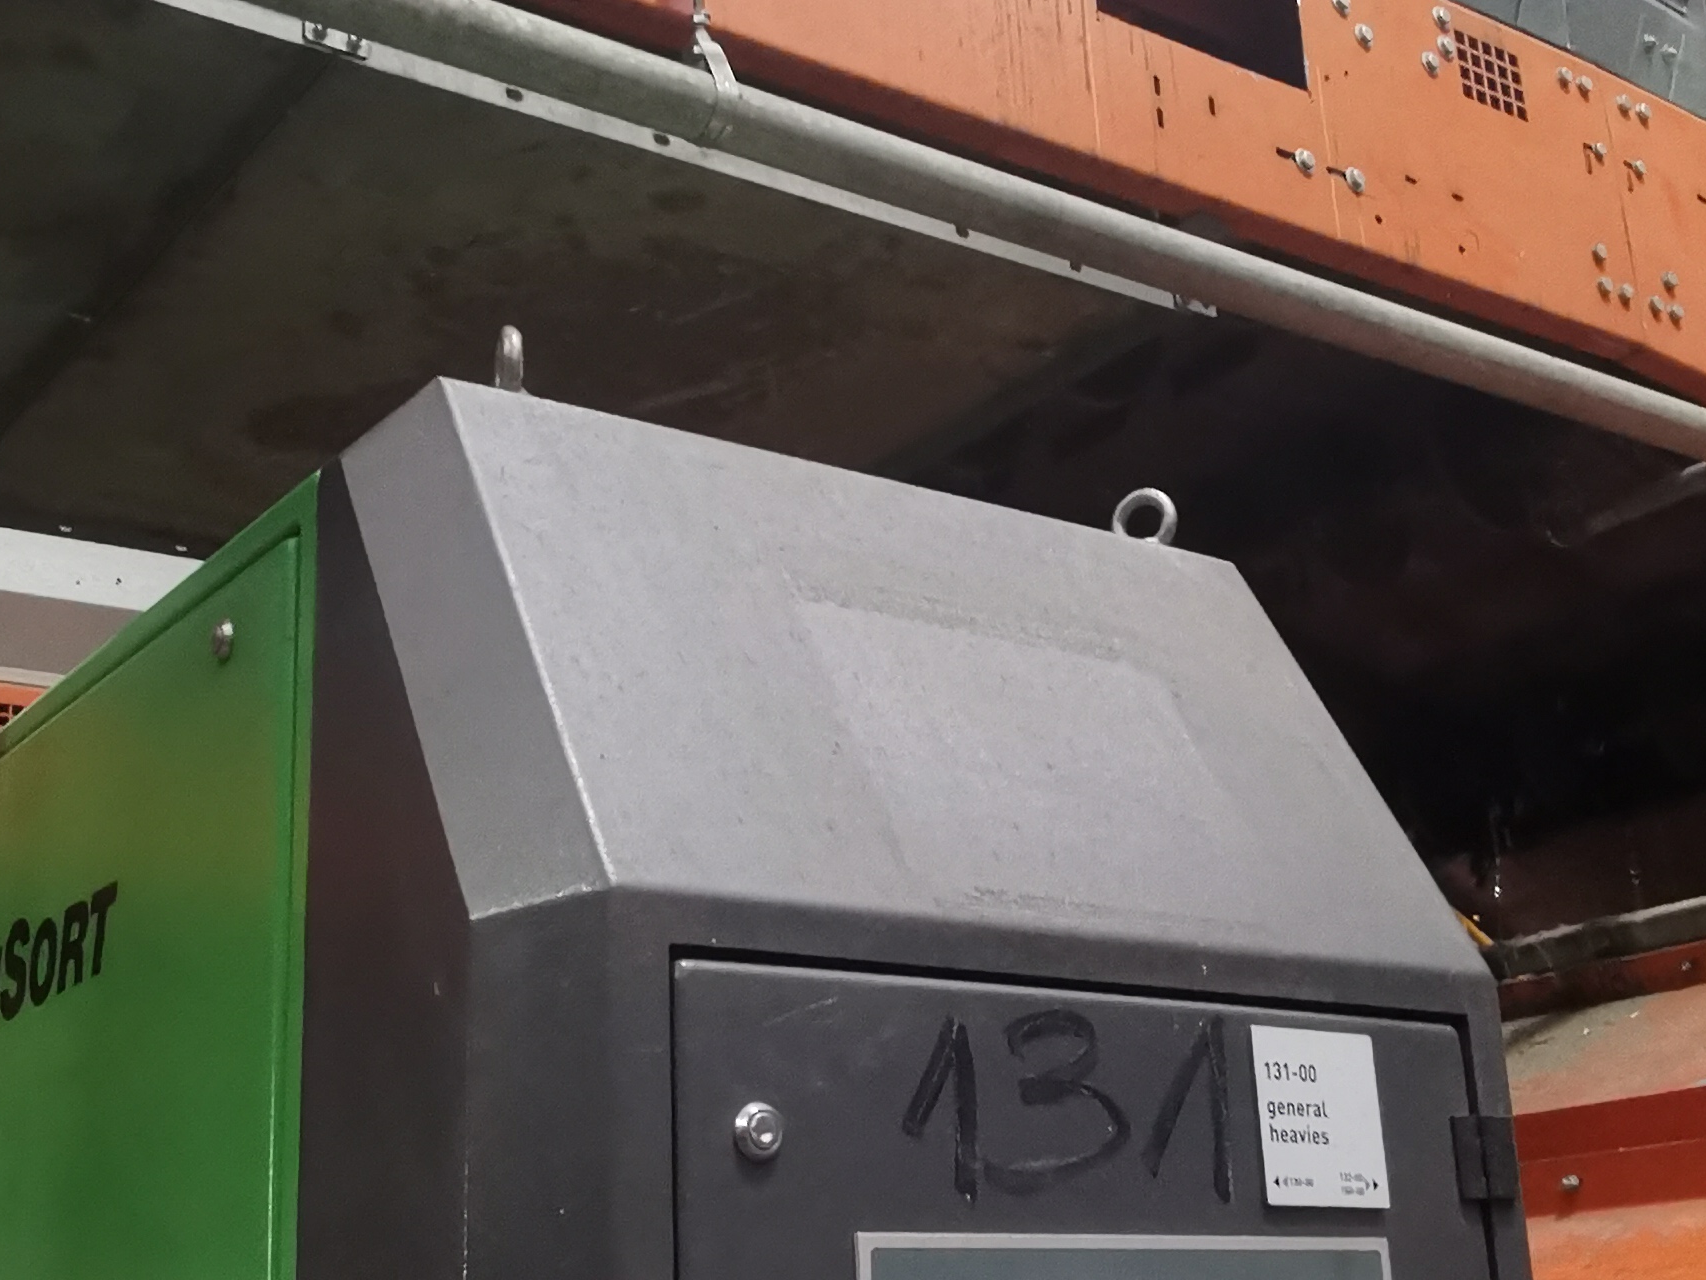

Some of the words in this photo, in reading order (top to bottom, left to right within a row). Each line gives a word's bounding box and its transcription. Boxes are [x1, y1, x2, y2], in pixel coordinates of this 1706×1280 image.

[1263, 1061, 1318, 1084] 131-00
[901, 1009, 1232, 1206] 131
[1266, 1099, 1330, 1120] general
[1268, 1122, 1330, 1146] heavies
